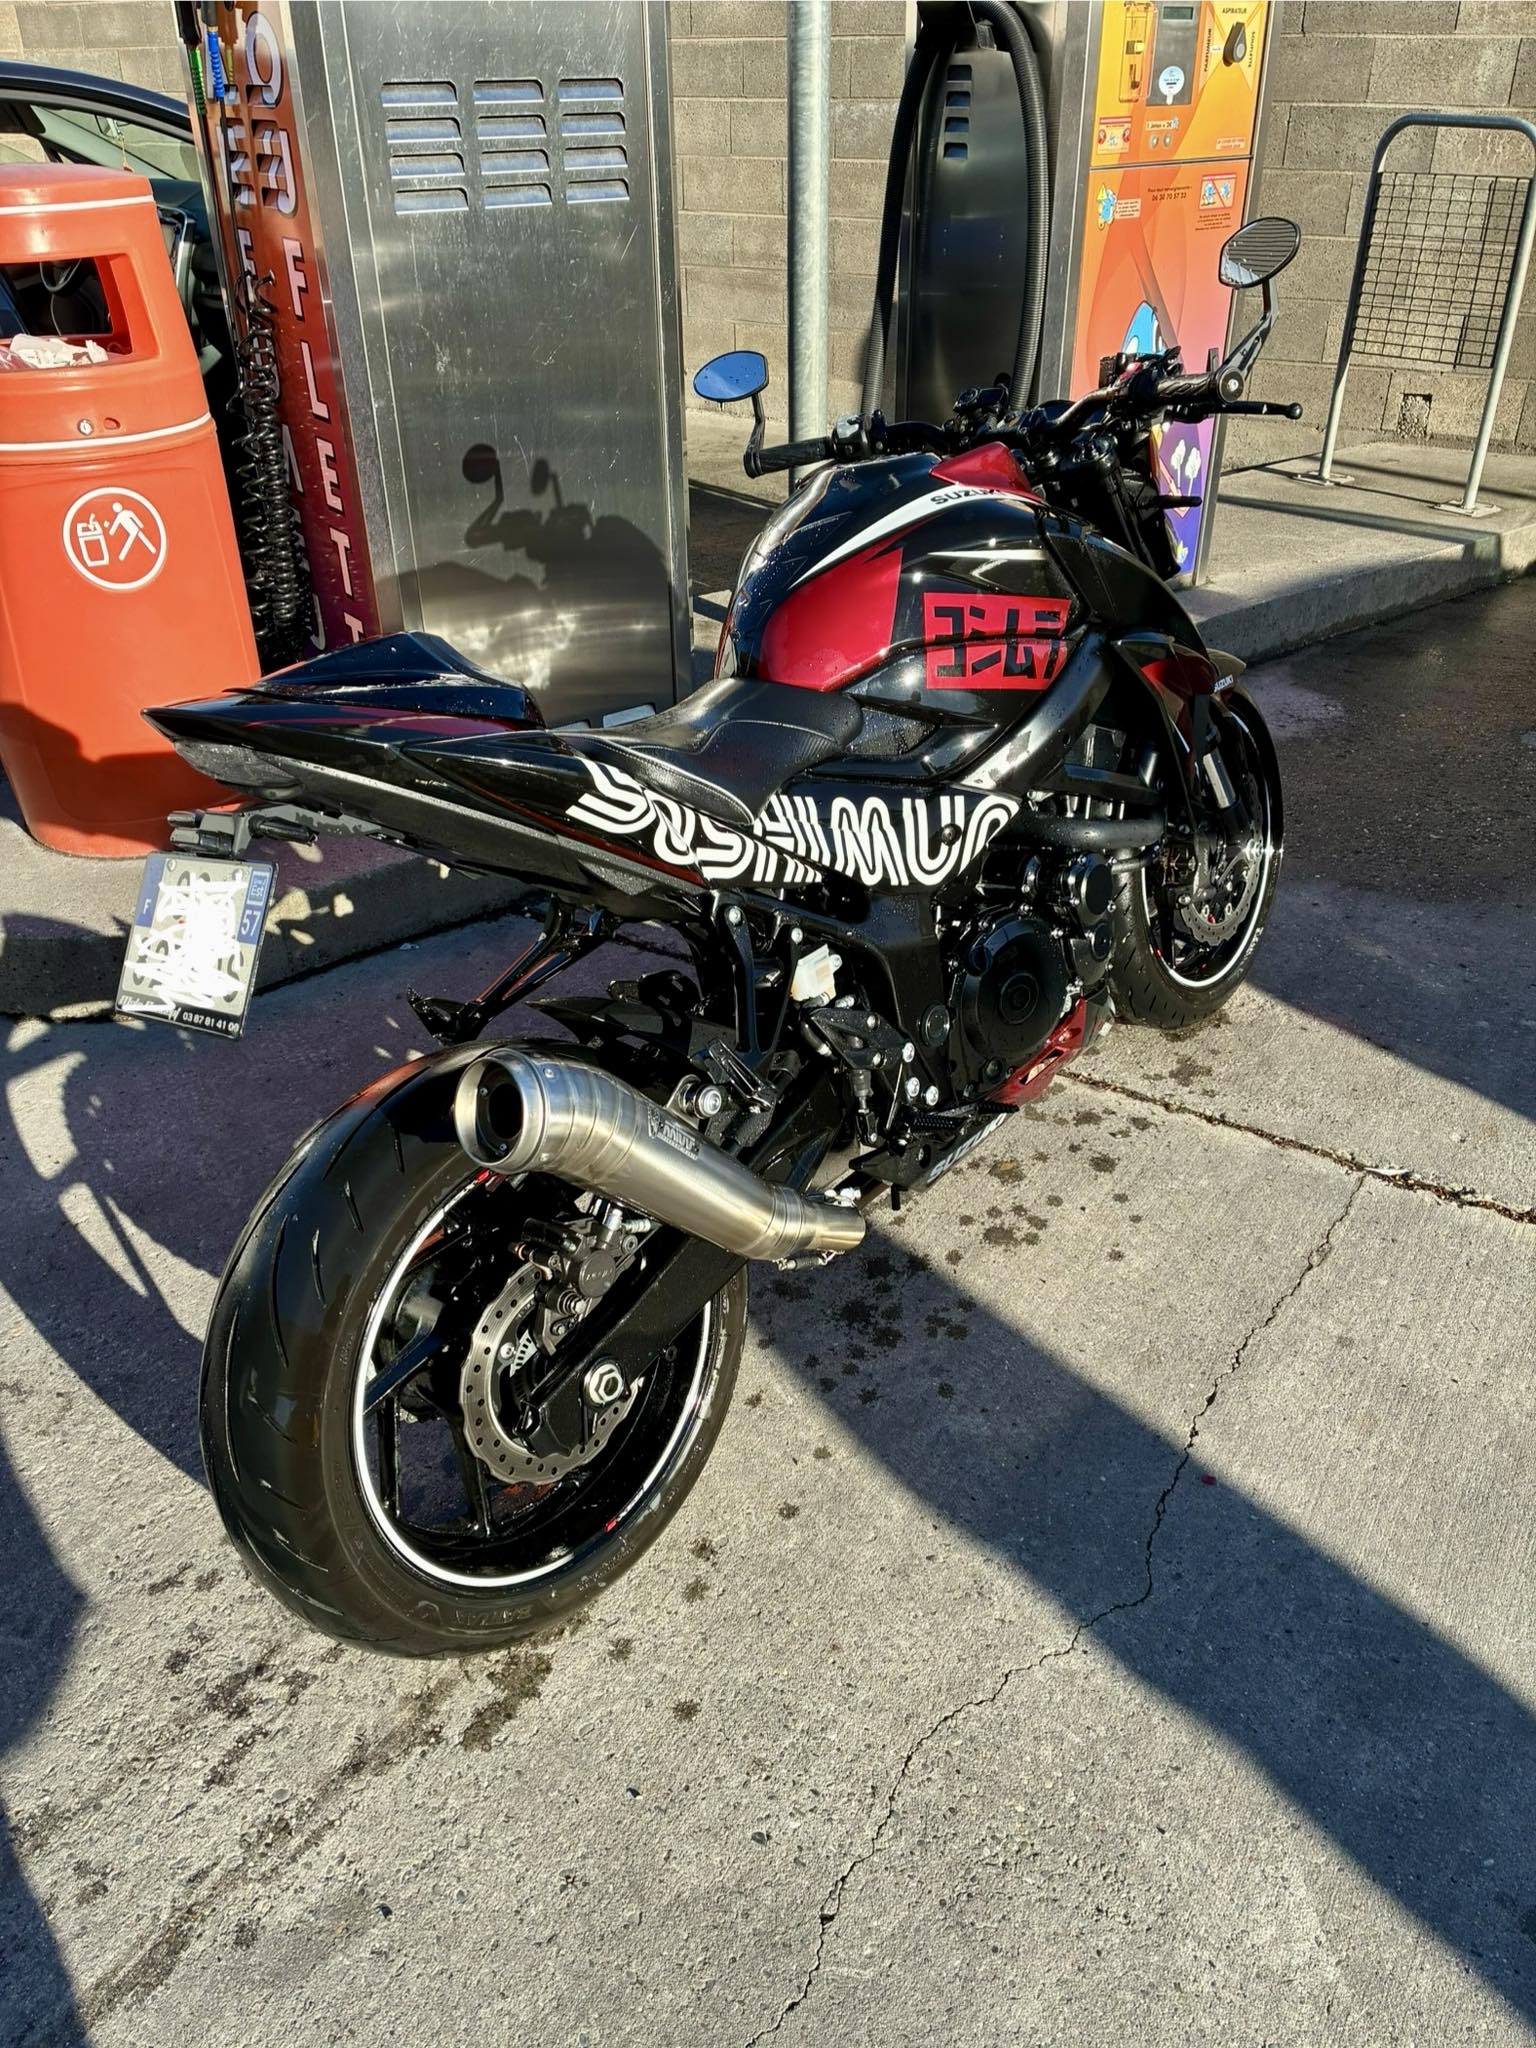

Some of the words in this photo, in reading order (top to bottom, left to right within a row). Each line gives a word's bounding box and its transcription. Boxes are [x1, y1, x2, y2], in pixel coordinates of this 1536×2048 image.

[142, 899, 152, 916] F
[240, 908, 262, 937] 57
[182, 1011, 194, 1023] 03
[193, 1013, 206, 1025] 87
[216, 1018, 228, 1030] 41
